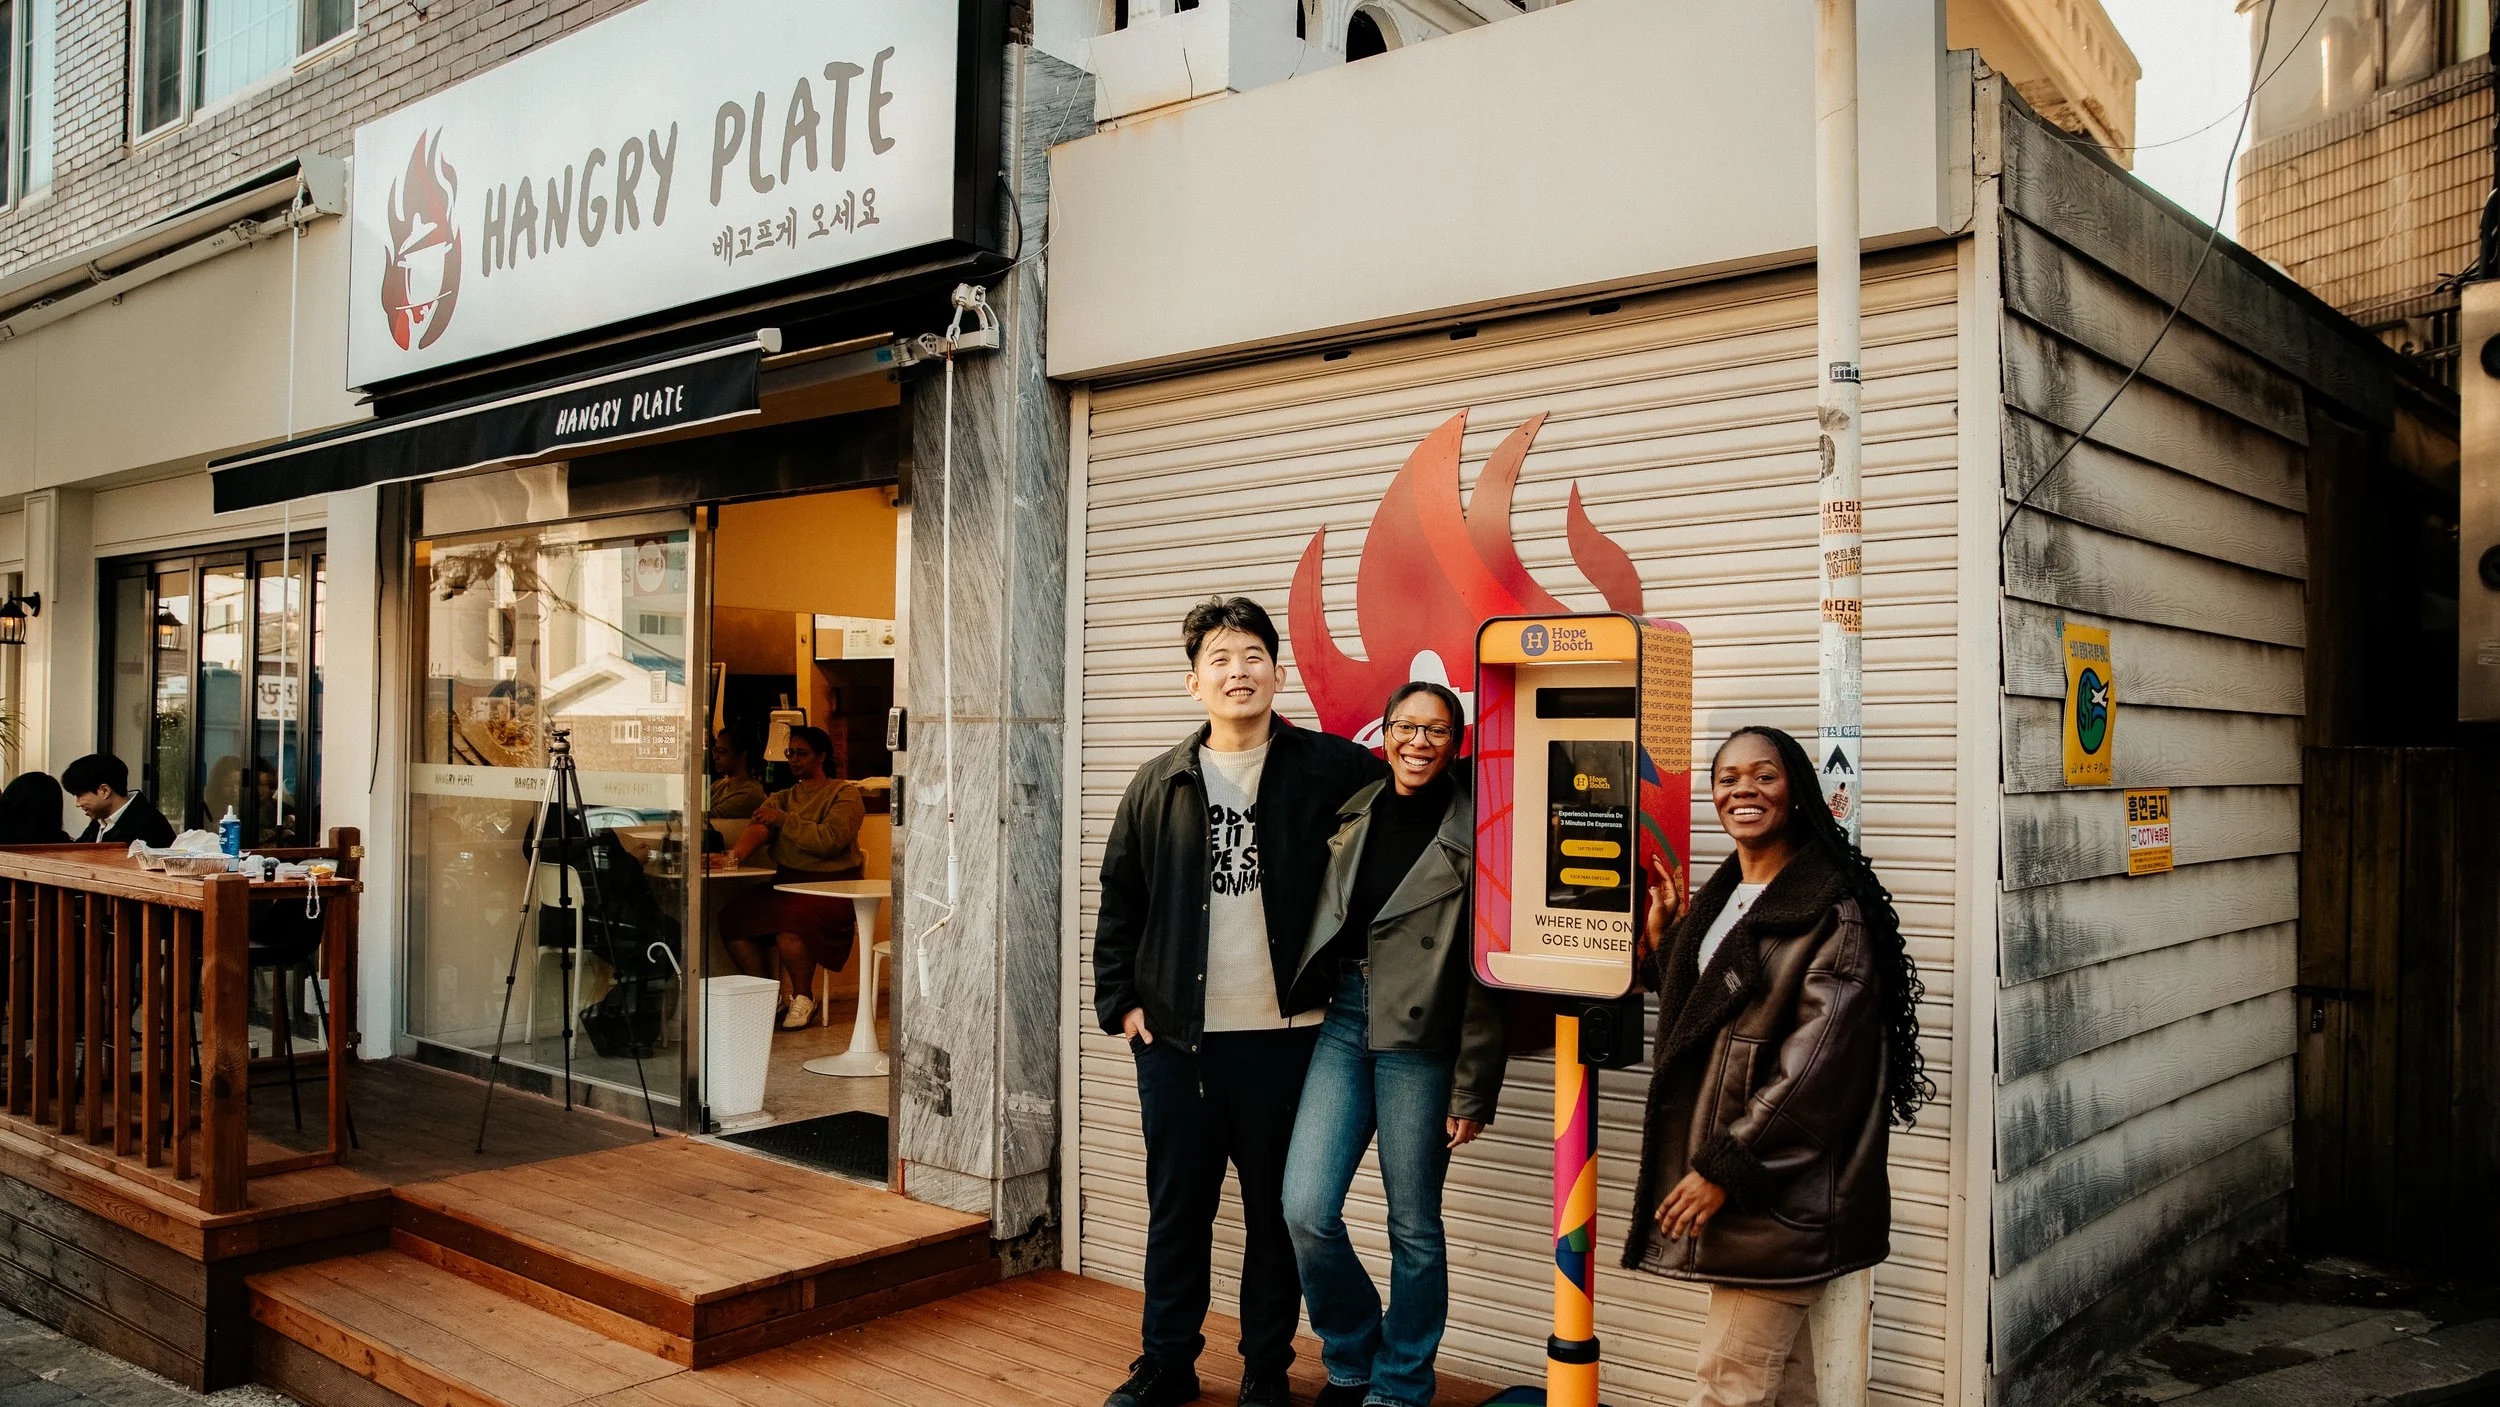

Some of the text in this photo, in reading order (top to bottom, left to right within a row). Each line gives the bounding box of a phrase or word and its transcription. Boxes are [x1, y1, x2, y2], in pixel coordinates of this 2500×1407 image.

[482, 45, 897, 278] HANGRY PLATE
[713, 187, 881, 267] 배고프게 오세요
[555, 385, 685, 436] HANGRY PLATE
[1552, 628, 1587, 641] Hope
[1650, 633, 1662, 641] HOPE
[1663, 635, 1675, 643] HOPE
[1676, 637, 1687, 645] HOPE
[1553, 638, 1593, 651] Booth
[1647, 644, 1659, 652] HOPE
[1660, 646, 1672, 654] HOPE
[1673, 648, 1684, 656] HOPE
[1651, 656, 1663, 664] HOPE
[1663, 657, 1675, 665] HOPE
[1676, 659, 1687, 667] HOPE
[1647, 666, 1659, 674] HOPE
[1660, 668, 1672, 676] HOPE
[1672, 669, 1684, 678] HOPE
[1651, 678, 1662, 686] HOPE
[1663, 679, 1675, 687] HOPE
[1675, 681, 1687, 689] HOPE
[1647, 689, 1659, 697] HOPE
[1660, 690, 1672, 698] HOPE
[1672, 691, 1684, 699] HOPE
[1650, 702, 1662, 710] HOPE
[1663, 703, 1674, 711] HOPE
[1675, 704, 1686, 712] HOPE
[1647, 713, 1659, 721] HOPE
[1660, 714, 1671, 722] HOPE
[1672, 715, 1683, 723] HOPE
[1650, 725, 1662, 733] HOPE
[1675, 726, 1687, 734] HOPE
[1672, 737, 1683, 745] HOPE
[1650, 747, 1686, 756] HOPE HOPE HOPE
[1659, 758, 1671, 766] HOPE
[1672, 759, 1683, 767] HOPE
[434, 773, 474, 786] HANGRY PLATE
[514, 776, 538, 790] HANGRY
[1589, 776, 1607, 784] Hope
[1589, 781, 1610, 789] Booth
[1558, 810, 1588, 818] Experiencia
[1589, 811, 1615, 819] Inmersiva
[2128, 795, 2168, 822] 흡연금지
[1535, 914, 1633, 934] WHERE NO ON
[1542, 934, 1579, 948] GOES
